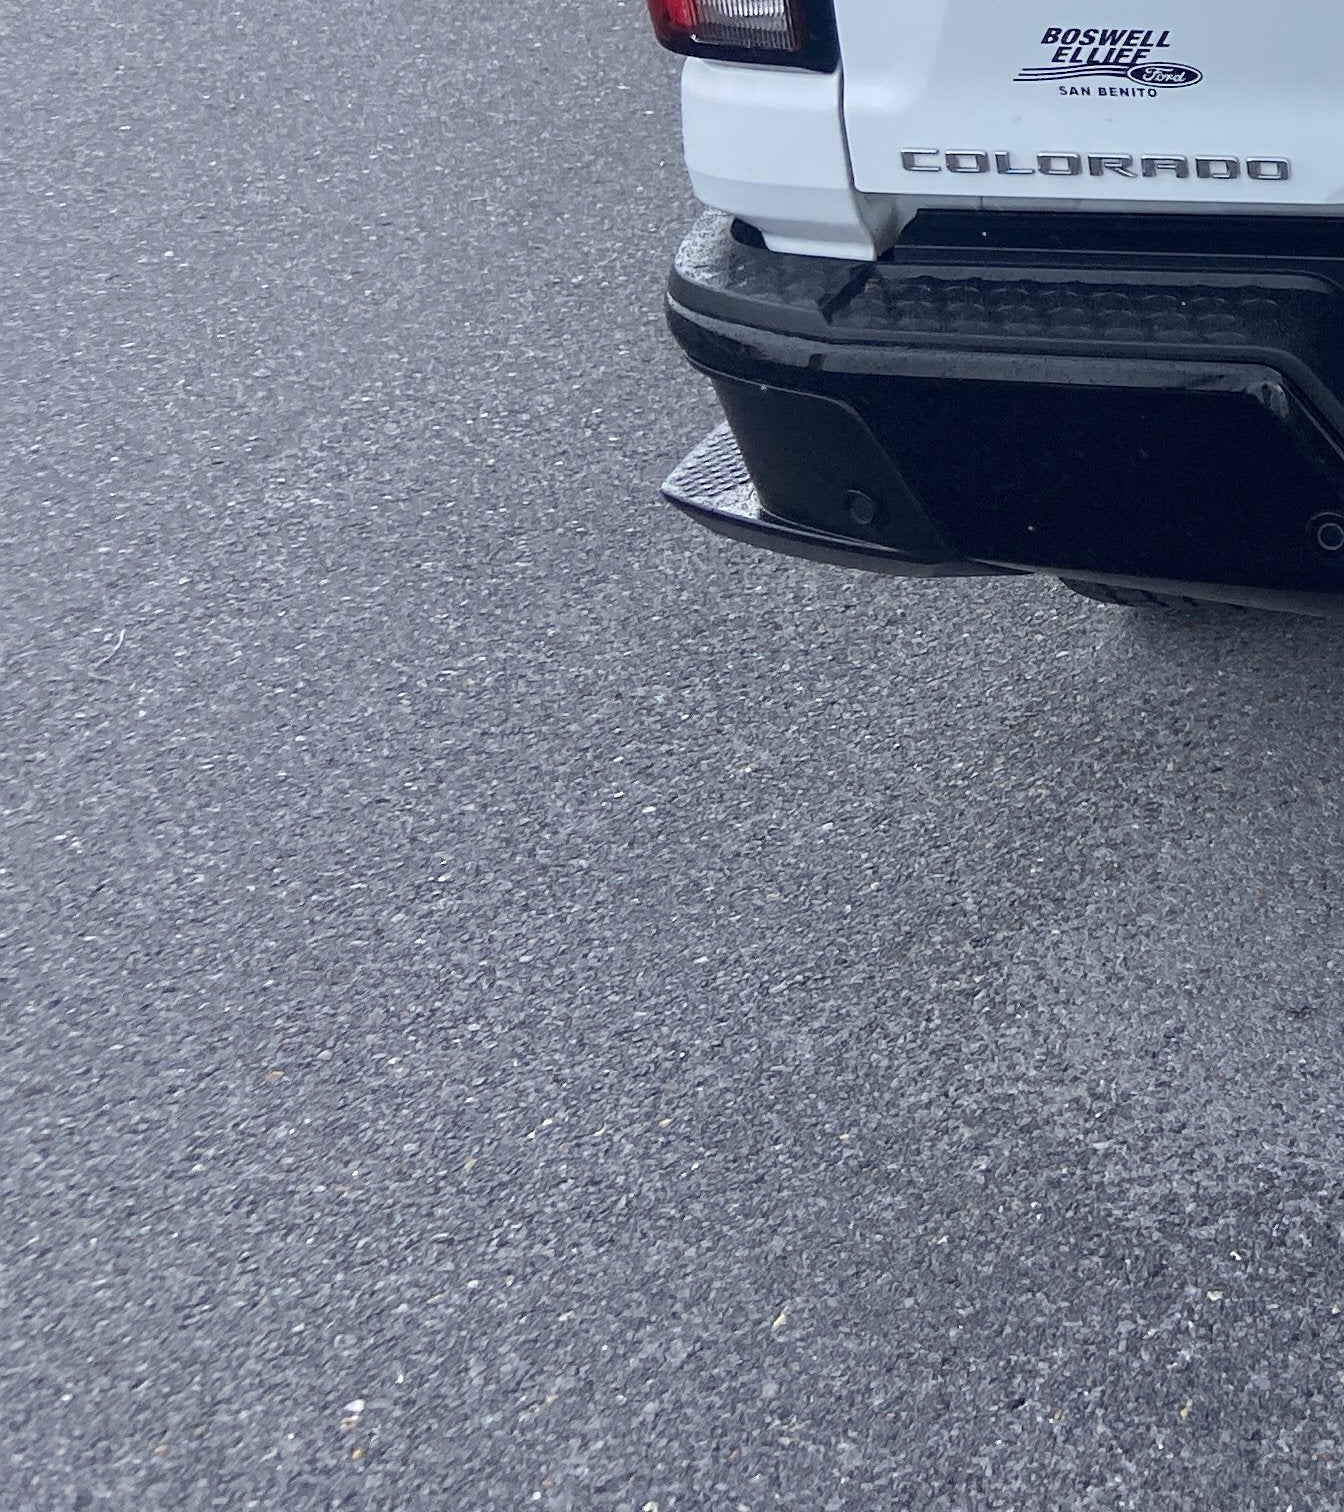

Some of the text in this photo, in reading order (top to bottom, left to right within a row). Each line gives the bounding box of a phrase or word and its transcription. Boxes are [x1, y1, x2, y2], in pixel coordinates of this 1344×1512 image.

[1041, 27, 1171, 48] BOSWELL
[1051, 46, 1151, 65] ELLIFF
[1142, 66, 1188, 83] Ford
[1058, 85, 1158, 98] SAN BENITO
[900, 148, 1292, 181] COLORADO
